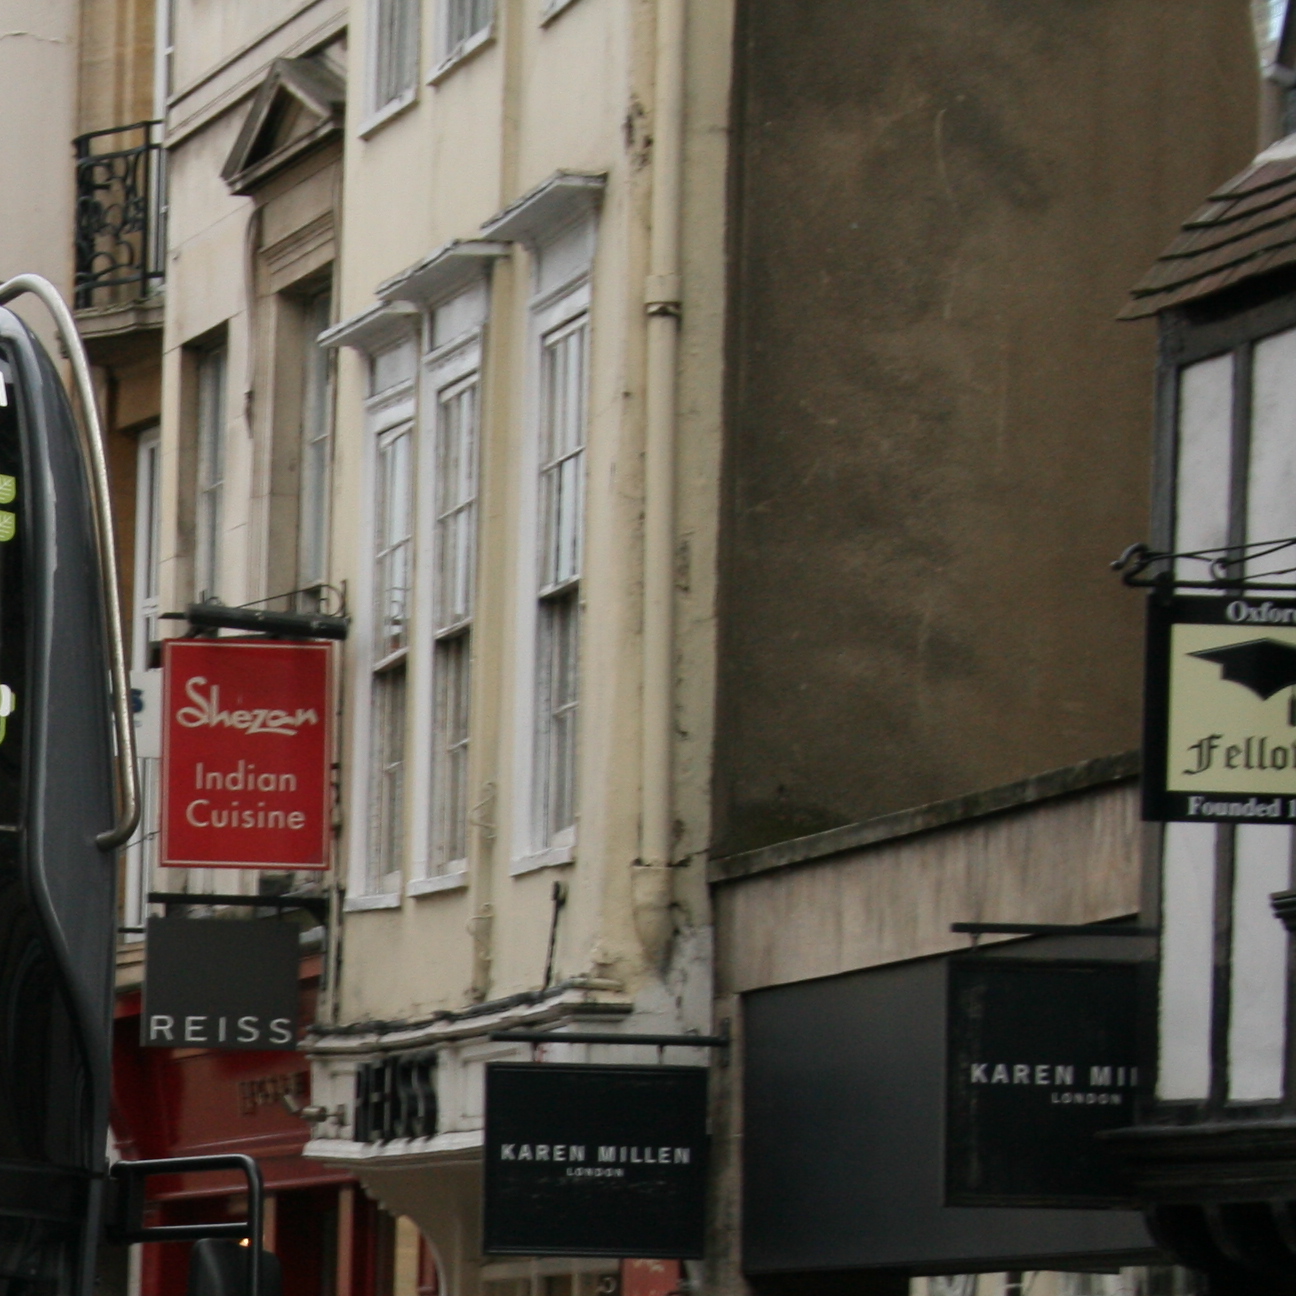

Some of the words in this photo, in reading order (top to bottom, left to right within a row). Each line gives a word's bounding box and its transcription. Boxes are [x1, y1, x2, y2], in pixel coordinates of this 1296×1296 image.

[175, 676, 318, 736] Shezan
[1182, 733, 1296, 775] Fello
[195, 761, 297, 793] Indian
[186, 798, 306, 830] Cuisine
[1187, 796, 1283, 818] Founded
[149, 1015, 293, 1042] REISS
[971, 1063, 1075, 1085] KAREN
[500, 1143, 586, 1163] KAREN
[597, 1145, 692, 1164] MILLEN
